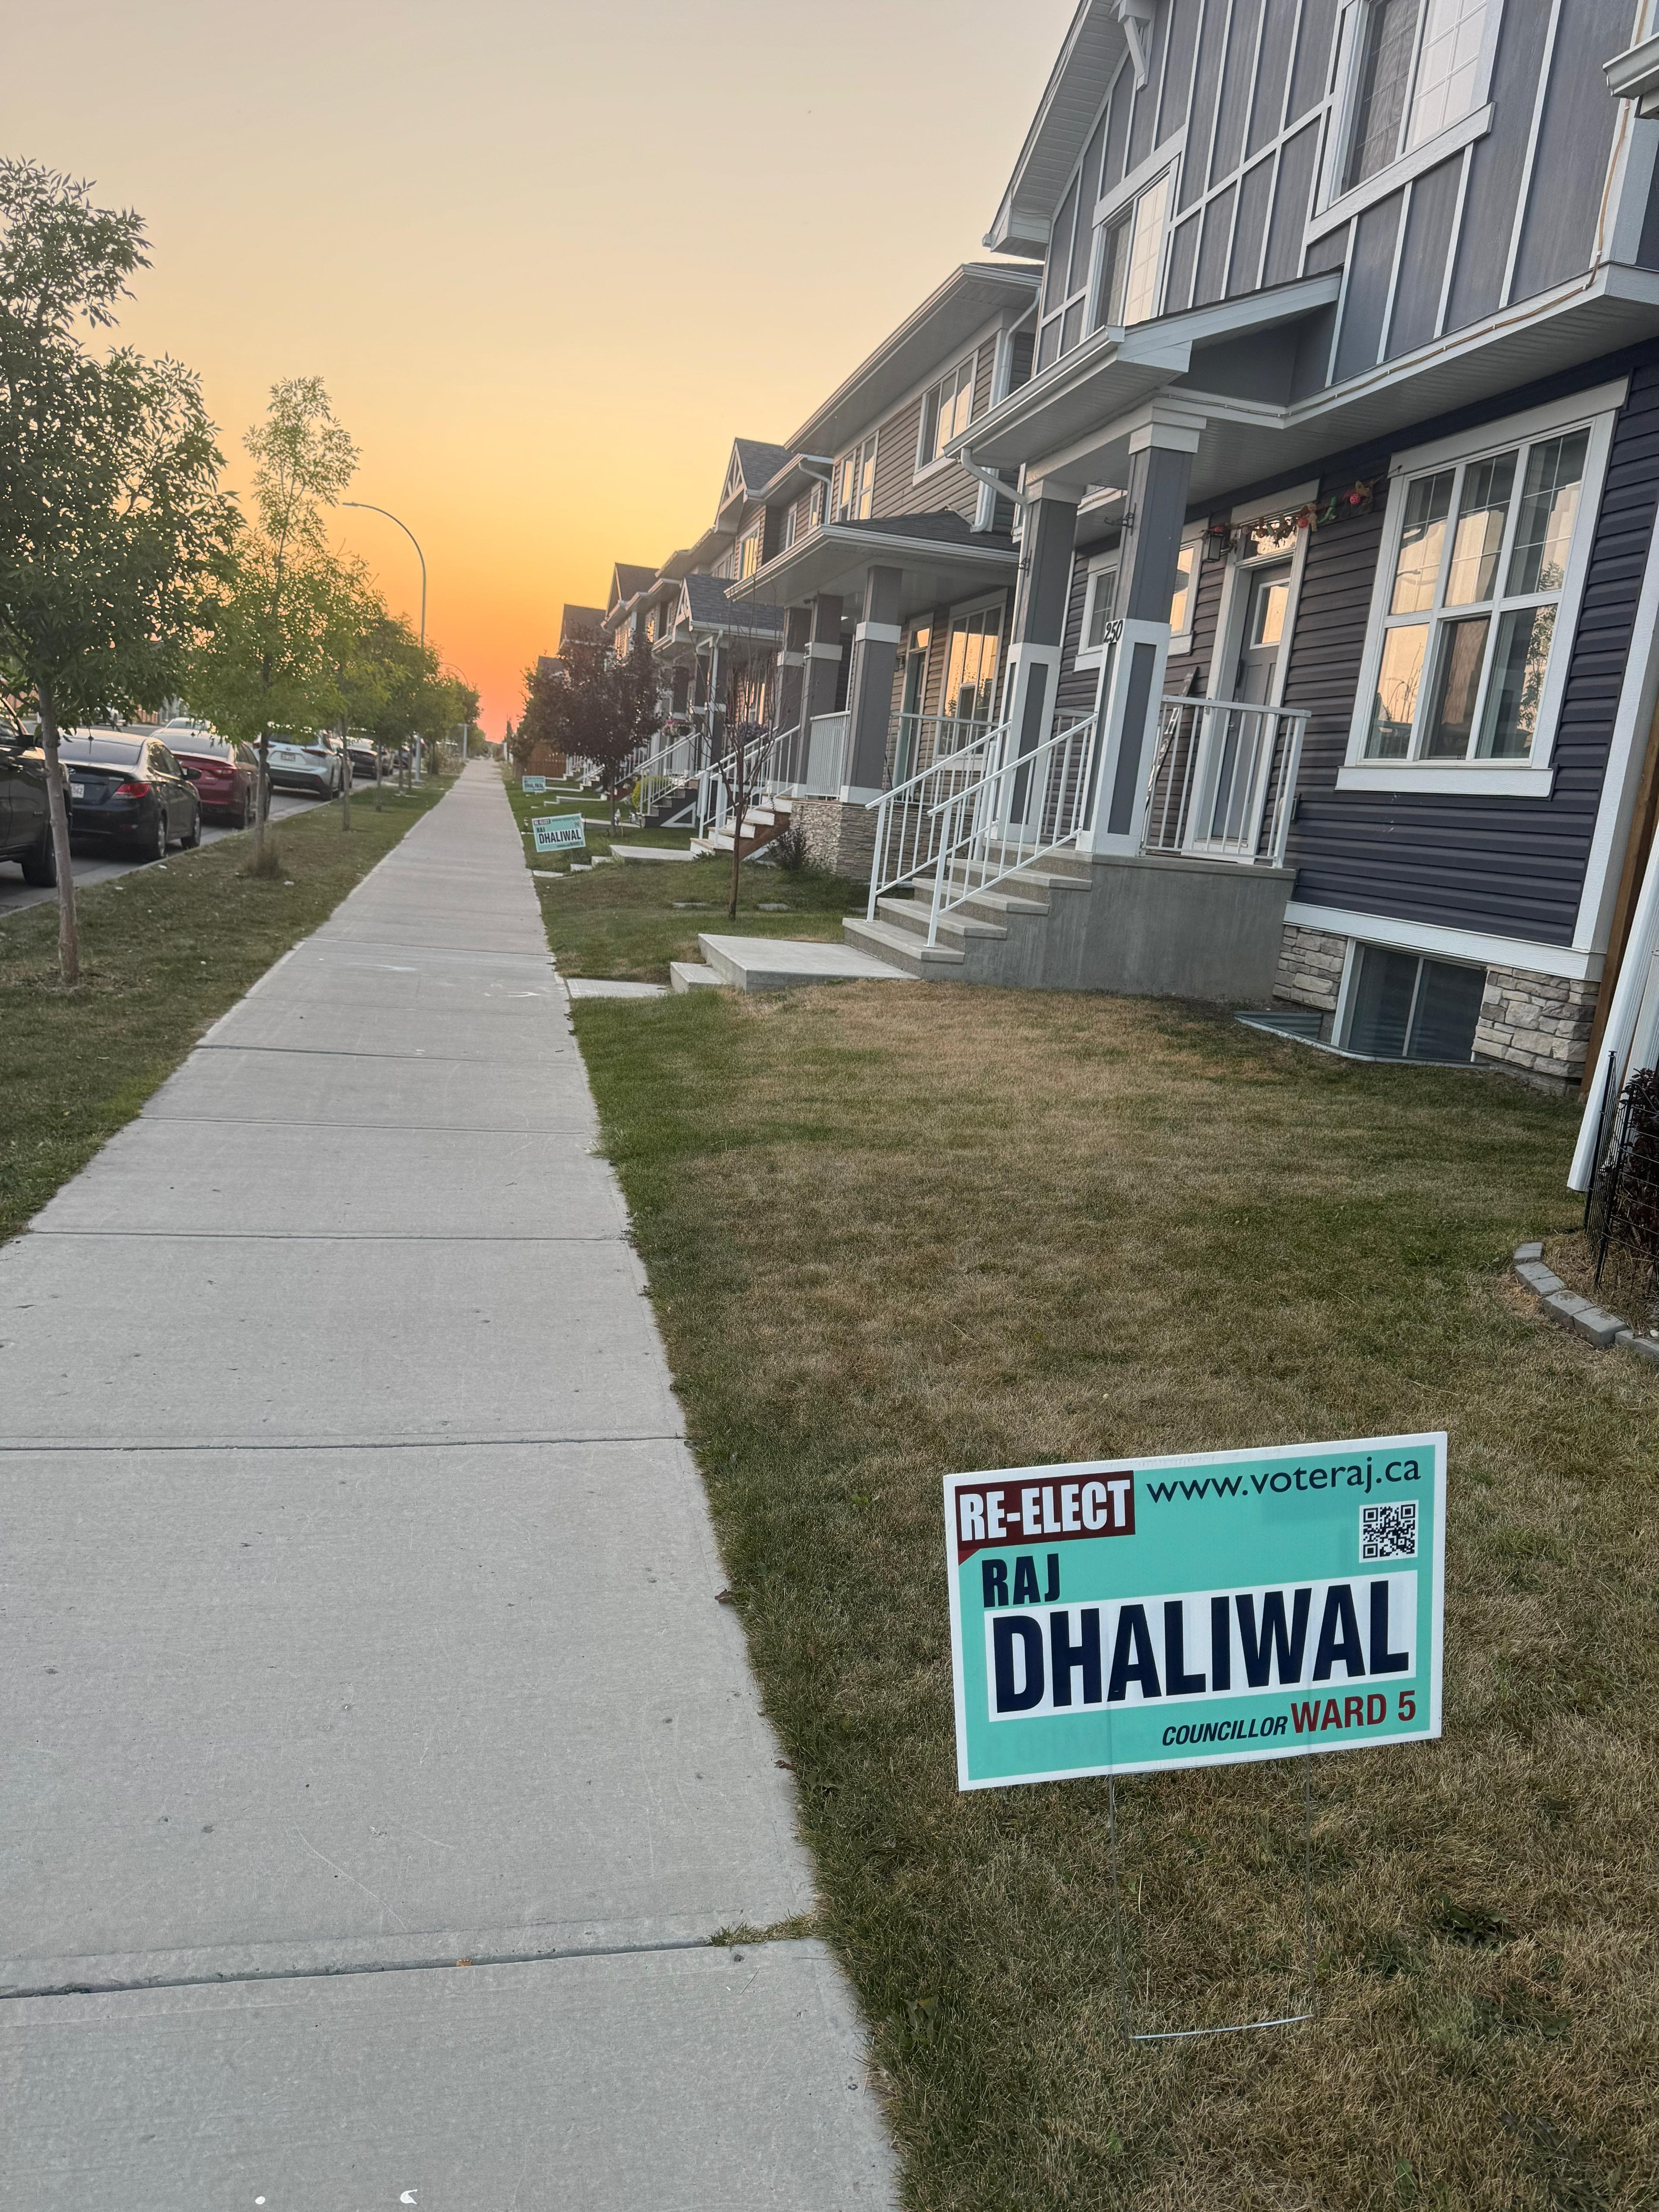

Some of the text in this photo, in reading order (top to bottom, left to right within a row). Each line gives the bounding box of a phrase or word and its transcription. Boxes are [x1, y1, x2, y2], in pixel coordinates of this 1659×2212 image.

[1103, 620, 1123, 643] 250
[539, 830, 582, 844] DHALIWAL
[1146, 1456, 1421, 1503] www.voteraj.ca
[960, 1479, 1130, 1541] RE-ELECT
[982, 1553, 1060, 1608] RAJ
[993, 1580, 1409, 1714] DHALIWAL
[1162, 1690, 1416, 1746] COUNCILLOR WARD 5
